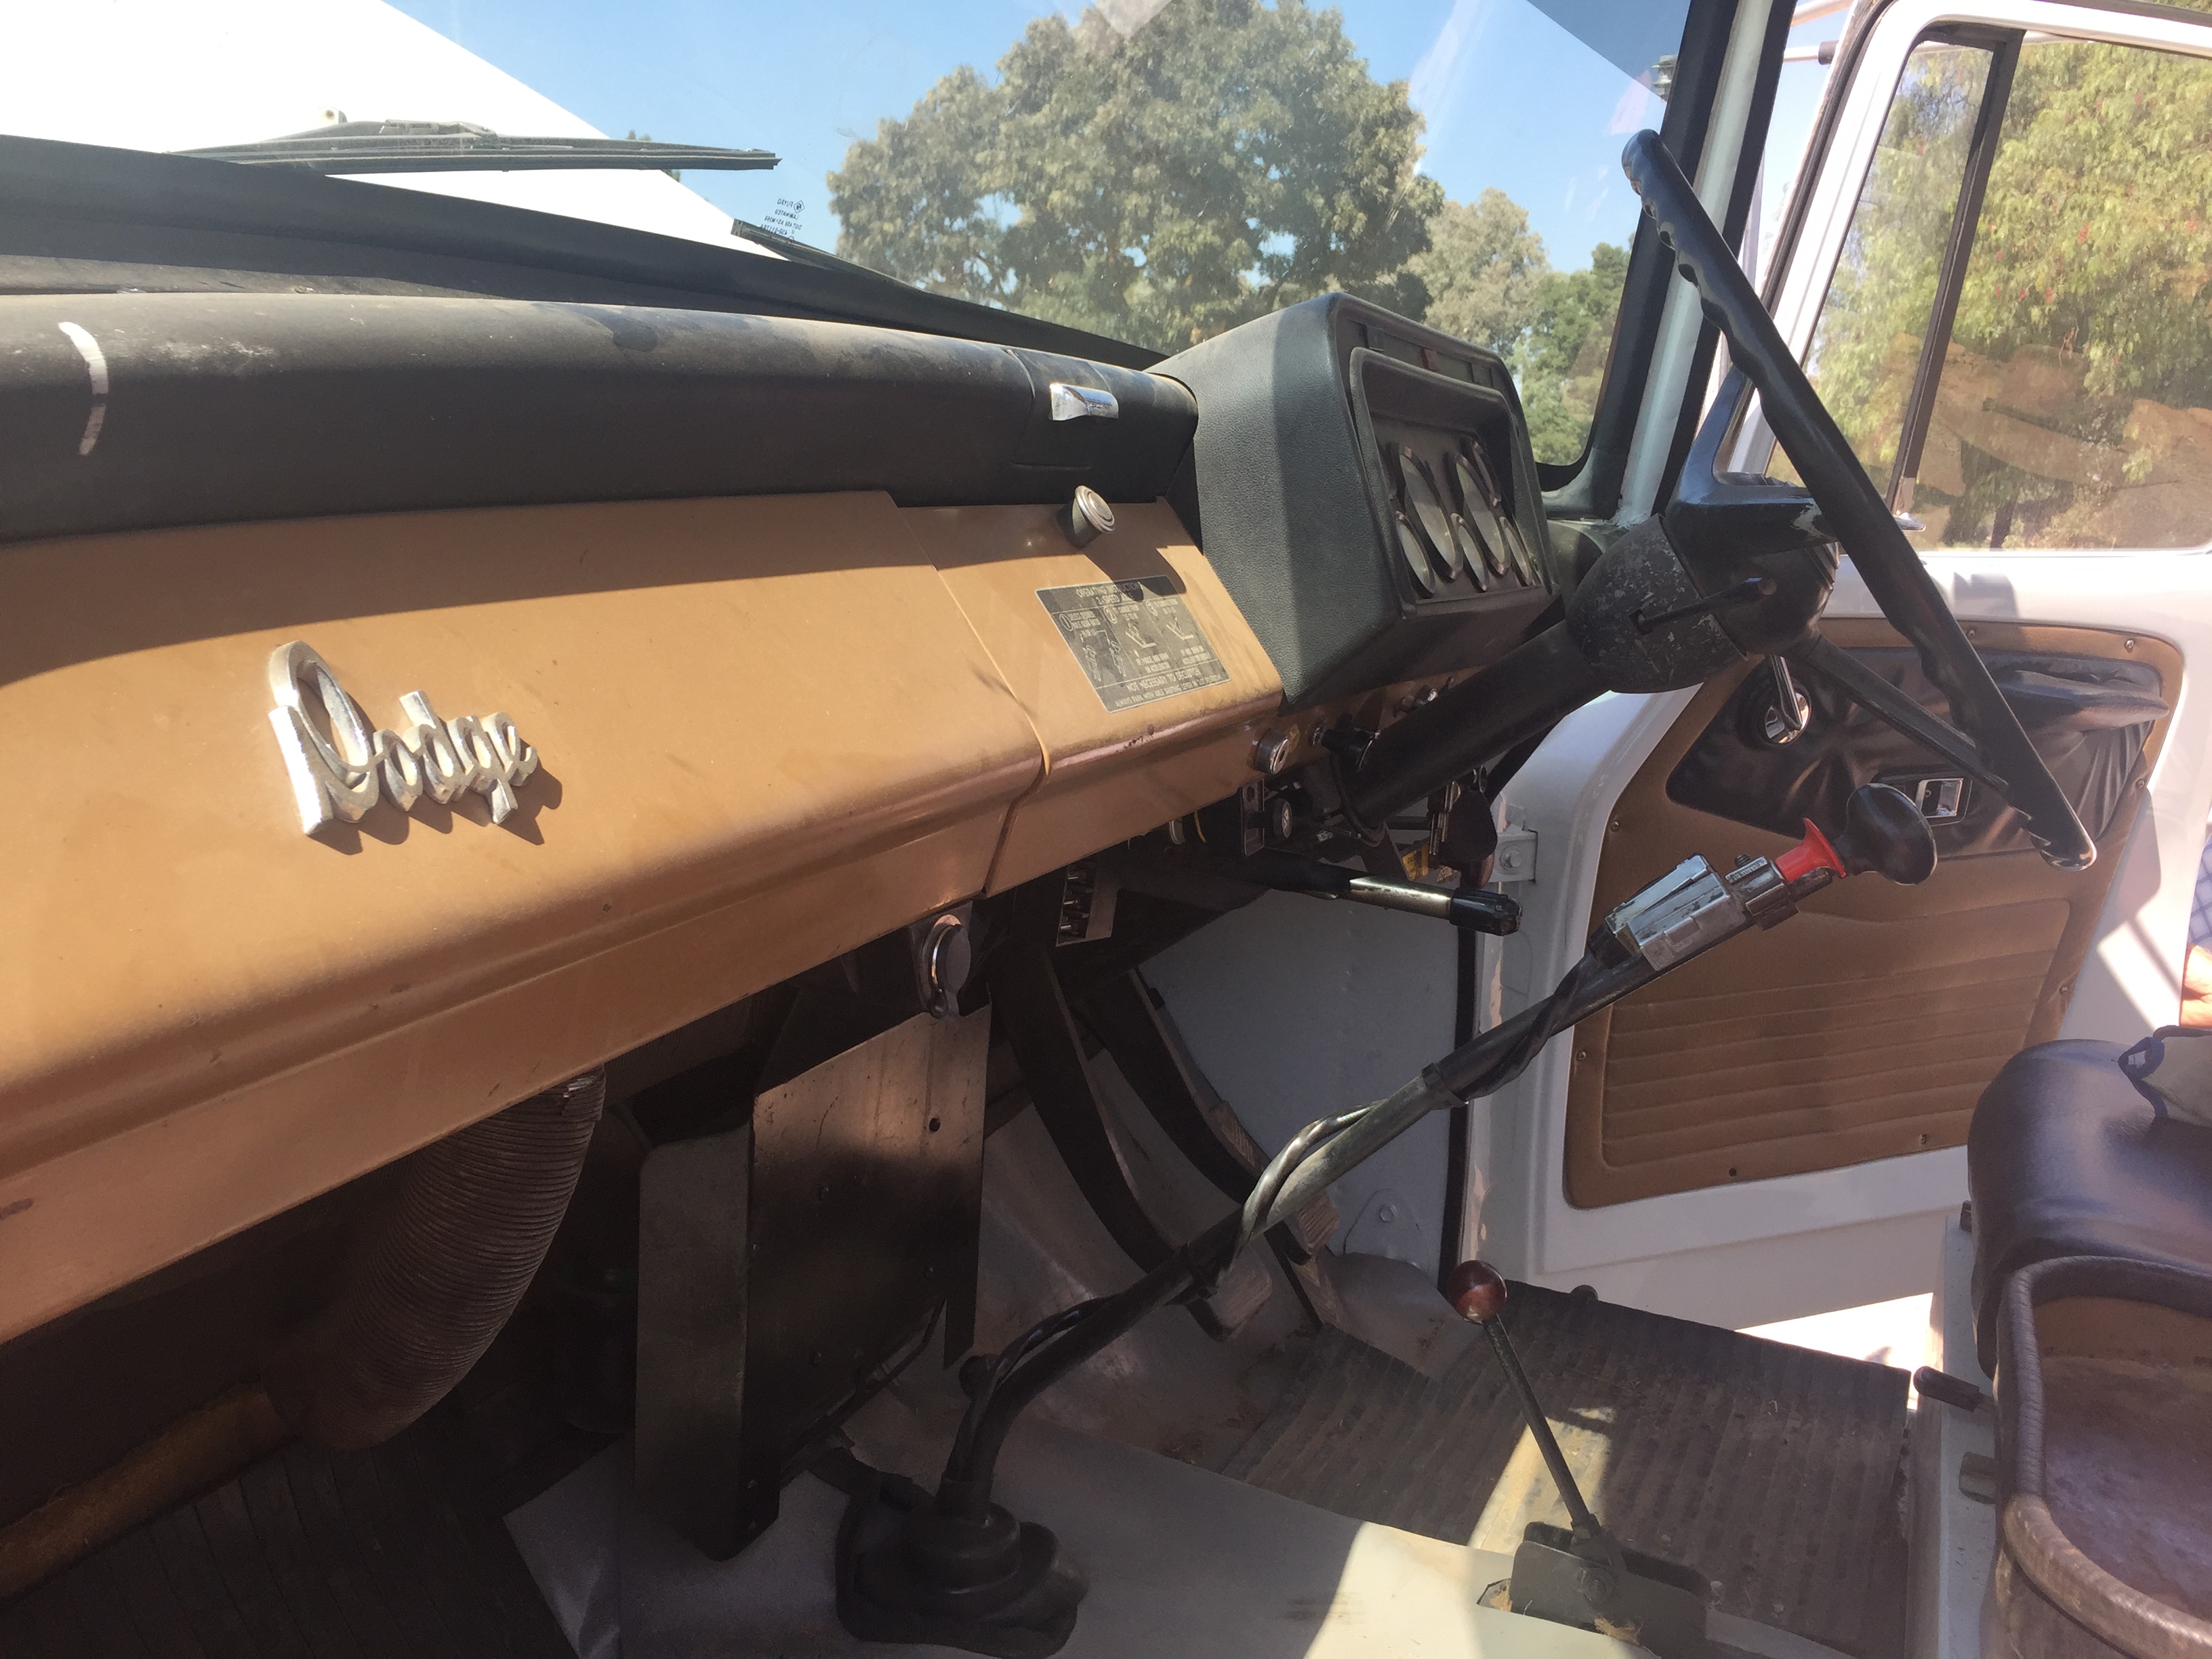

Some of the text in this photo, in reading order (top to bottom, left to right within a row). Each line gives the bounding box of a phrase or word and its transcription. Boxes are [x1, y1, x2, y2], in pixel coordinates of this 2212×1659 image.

[1075, 587, 1107, 598] OPERATING
[1126, 682, 1141, 693] NOT
[1139, 675, 1168, 689] NECESSARY
[1166, 673, 1177, 682] TO
[1175, 668, 1202, 680] DECLUTCH
[1114, 697, 1133, 708] ALWAYS
[1132, 695, 1144, 703] PARK
[268, 640, 539, 835] Dodge
